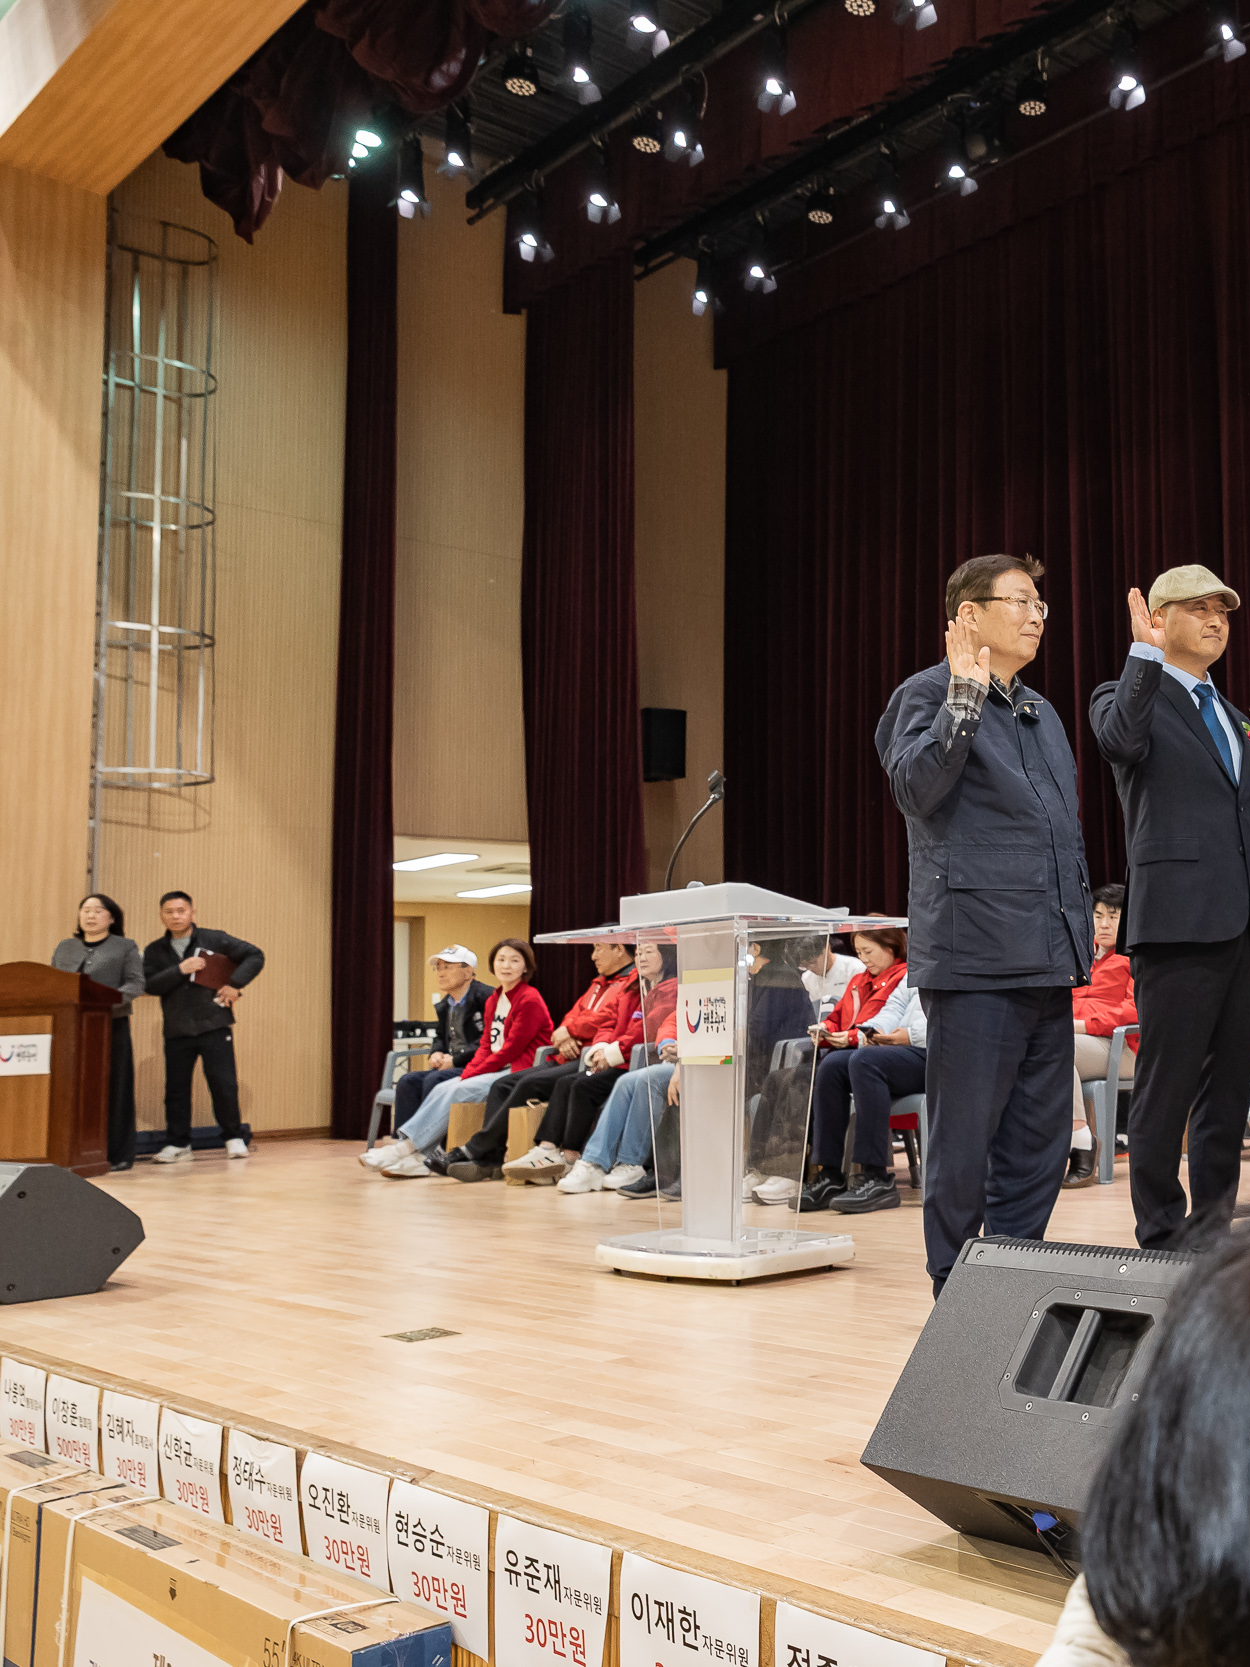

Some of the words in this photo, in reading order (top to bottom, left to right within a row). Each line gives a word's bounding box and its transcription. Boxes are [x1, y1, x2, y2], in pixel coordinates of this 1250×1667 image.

[9, 1418, 35, 1446] 30만원
[52, 1397, 78, 1427] 이창훈
[106, 1413, 135, 1446] 김혜자
[56, 1436, 91, 1467] 500만원
[163, 1433, 192, 1468] 신학균
[116, 1457, 147, 1488] 30만원
[233, 1455, 266, 1494] 정태수
[266, 1481, 292, 1501] 자문위원
[176, 1479, 209, 1514] 30만원
[308, 1484, 350, 1525] 오진환
[351, 1511, 381, 1534] 자문위원
[244, 1506, 283, 1544] 30만원
[395, 1510, 445, 1559] 현승순
[446, 1545, 481, 1572] 자문위원
[324, 1535, 371, 1578] 30만원
[411, 1571, 467, 1619] 30만원
[504, 1550, 562, 1603] 유준재
[563, 1586, 602, 1616] 자문위원
[525, 1613, 587, 1667] 30만원
[631, 1592, 700, 1651] 이재한
[702, 1633, 749, 1667] 자문위원
